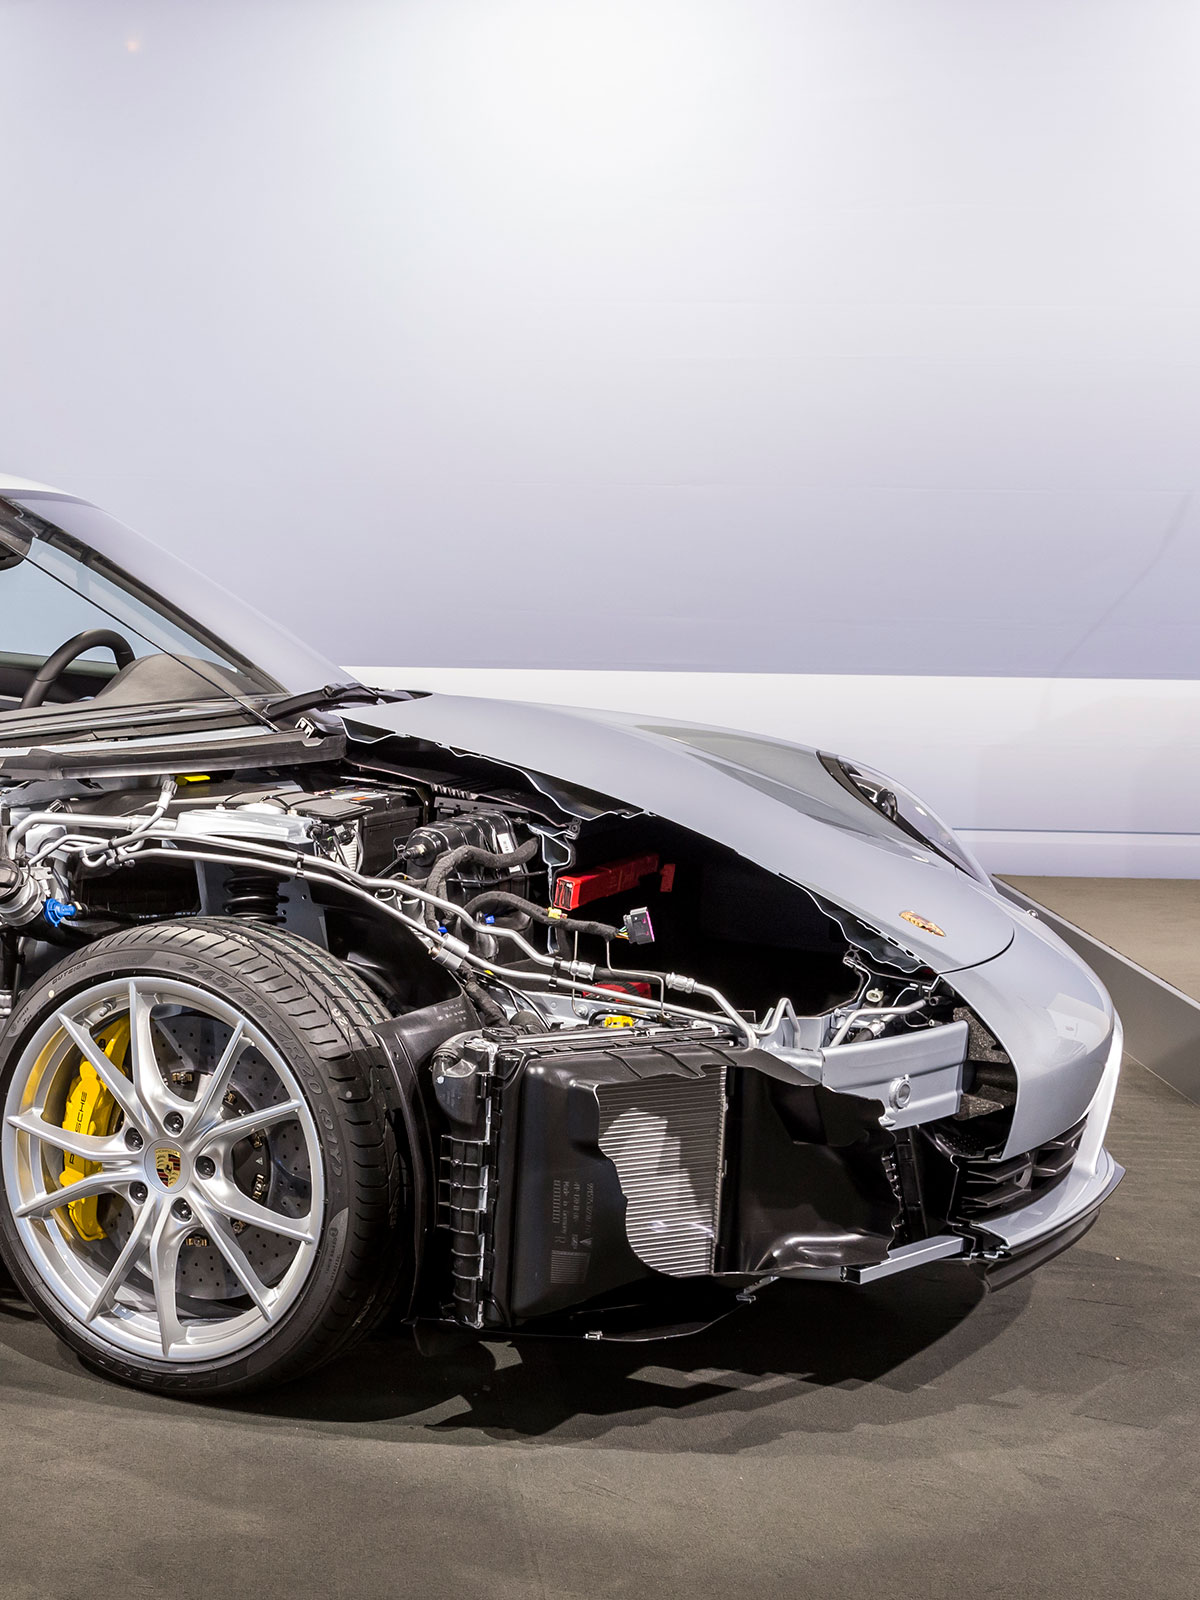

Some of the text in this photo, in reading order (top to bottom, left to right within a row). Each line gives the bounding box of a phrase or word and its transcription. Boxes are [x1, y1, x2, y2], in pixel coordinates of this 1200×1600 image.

[177, 961, 272, 1020] 245/35
[271, 1024, 324, 1095] ZR20
[68, 1090, 88, 1165] PSCHE
